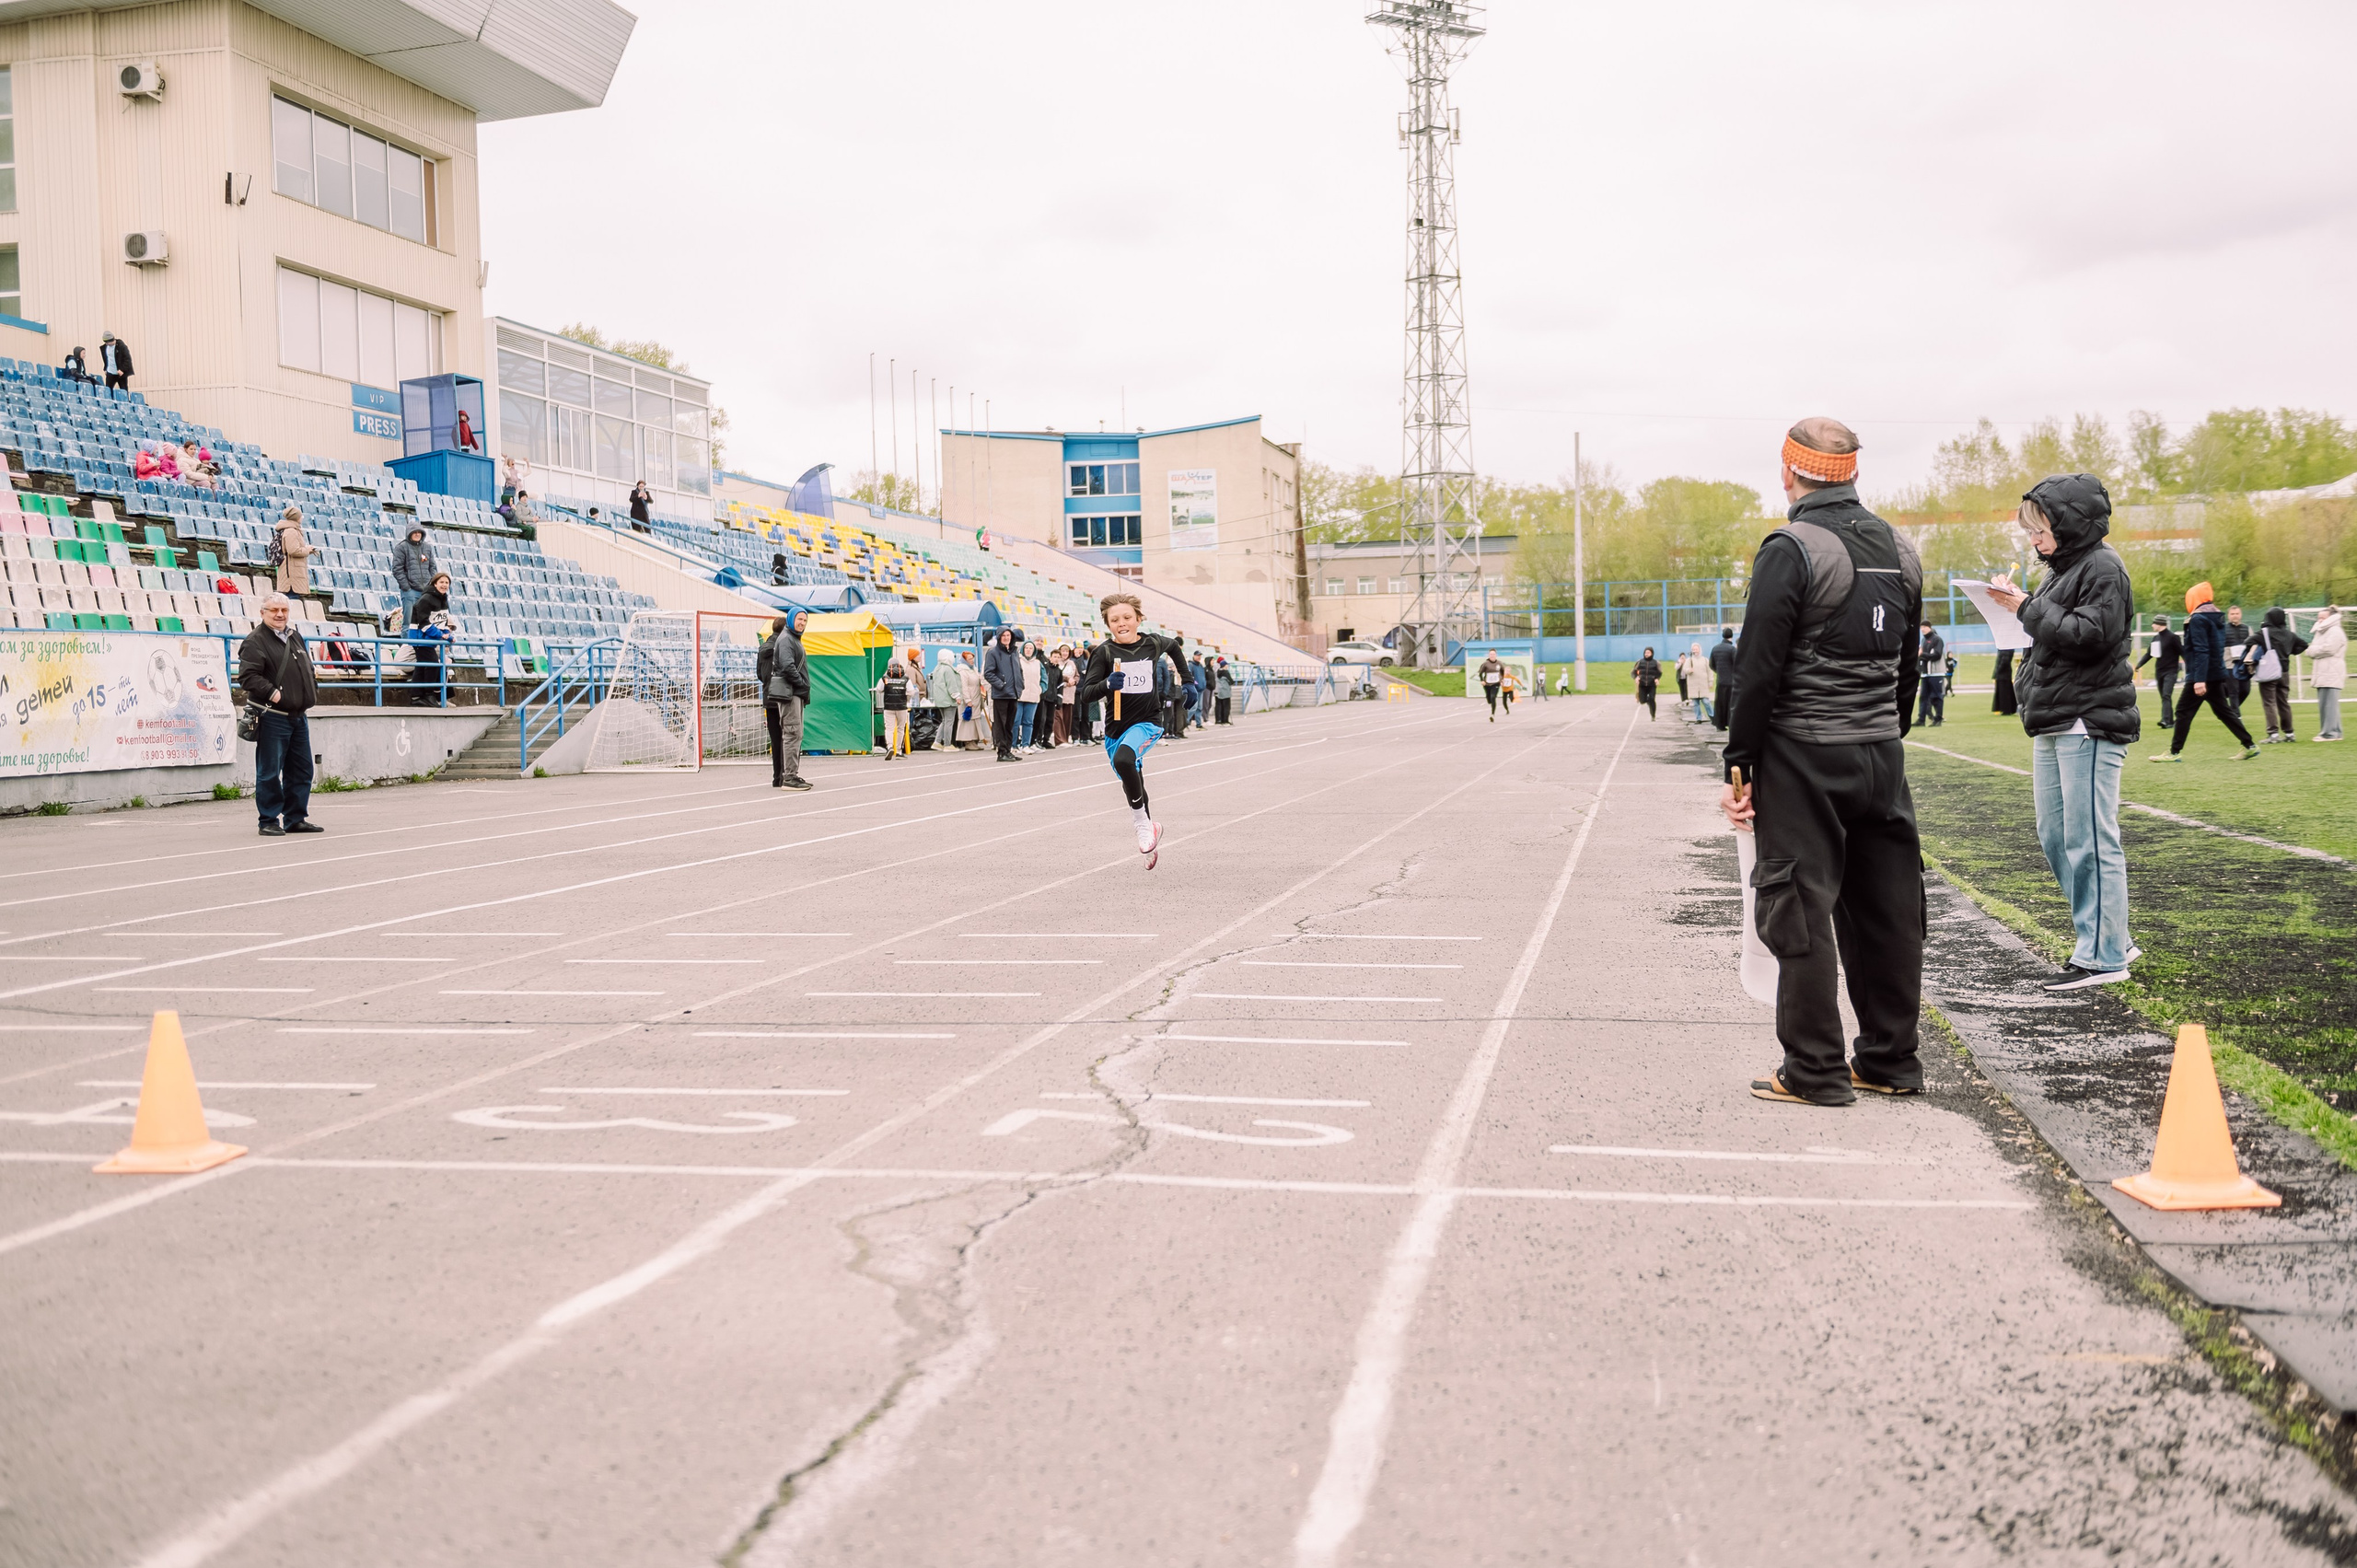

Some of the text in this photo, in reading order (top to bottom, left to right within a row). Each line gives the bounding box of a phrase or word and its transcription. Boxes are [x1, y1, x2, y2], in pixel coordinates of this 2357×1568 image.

[369, 393, 384, 404] VIP
[360, 414, 397, 436] PRESS
[20, 641, 35, 662] за
[38, 637, 112, 662] здоровьем!»
[1128, 676, 1145, 687] 129
[17, 675, 74, 725] детей
[73, 699, 87, 725] до
[115, 688, 138, 716] лет
[21, 754, 35, 765] на
[37, 747, 89, 772] здоровье!
[190, 749, 197, 759] 50
